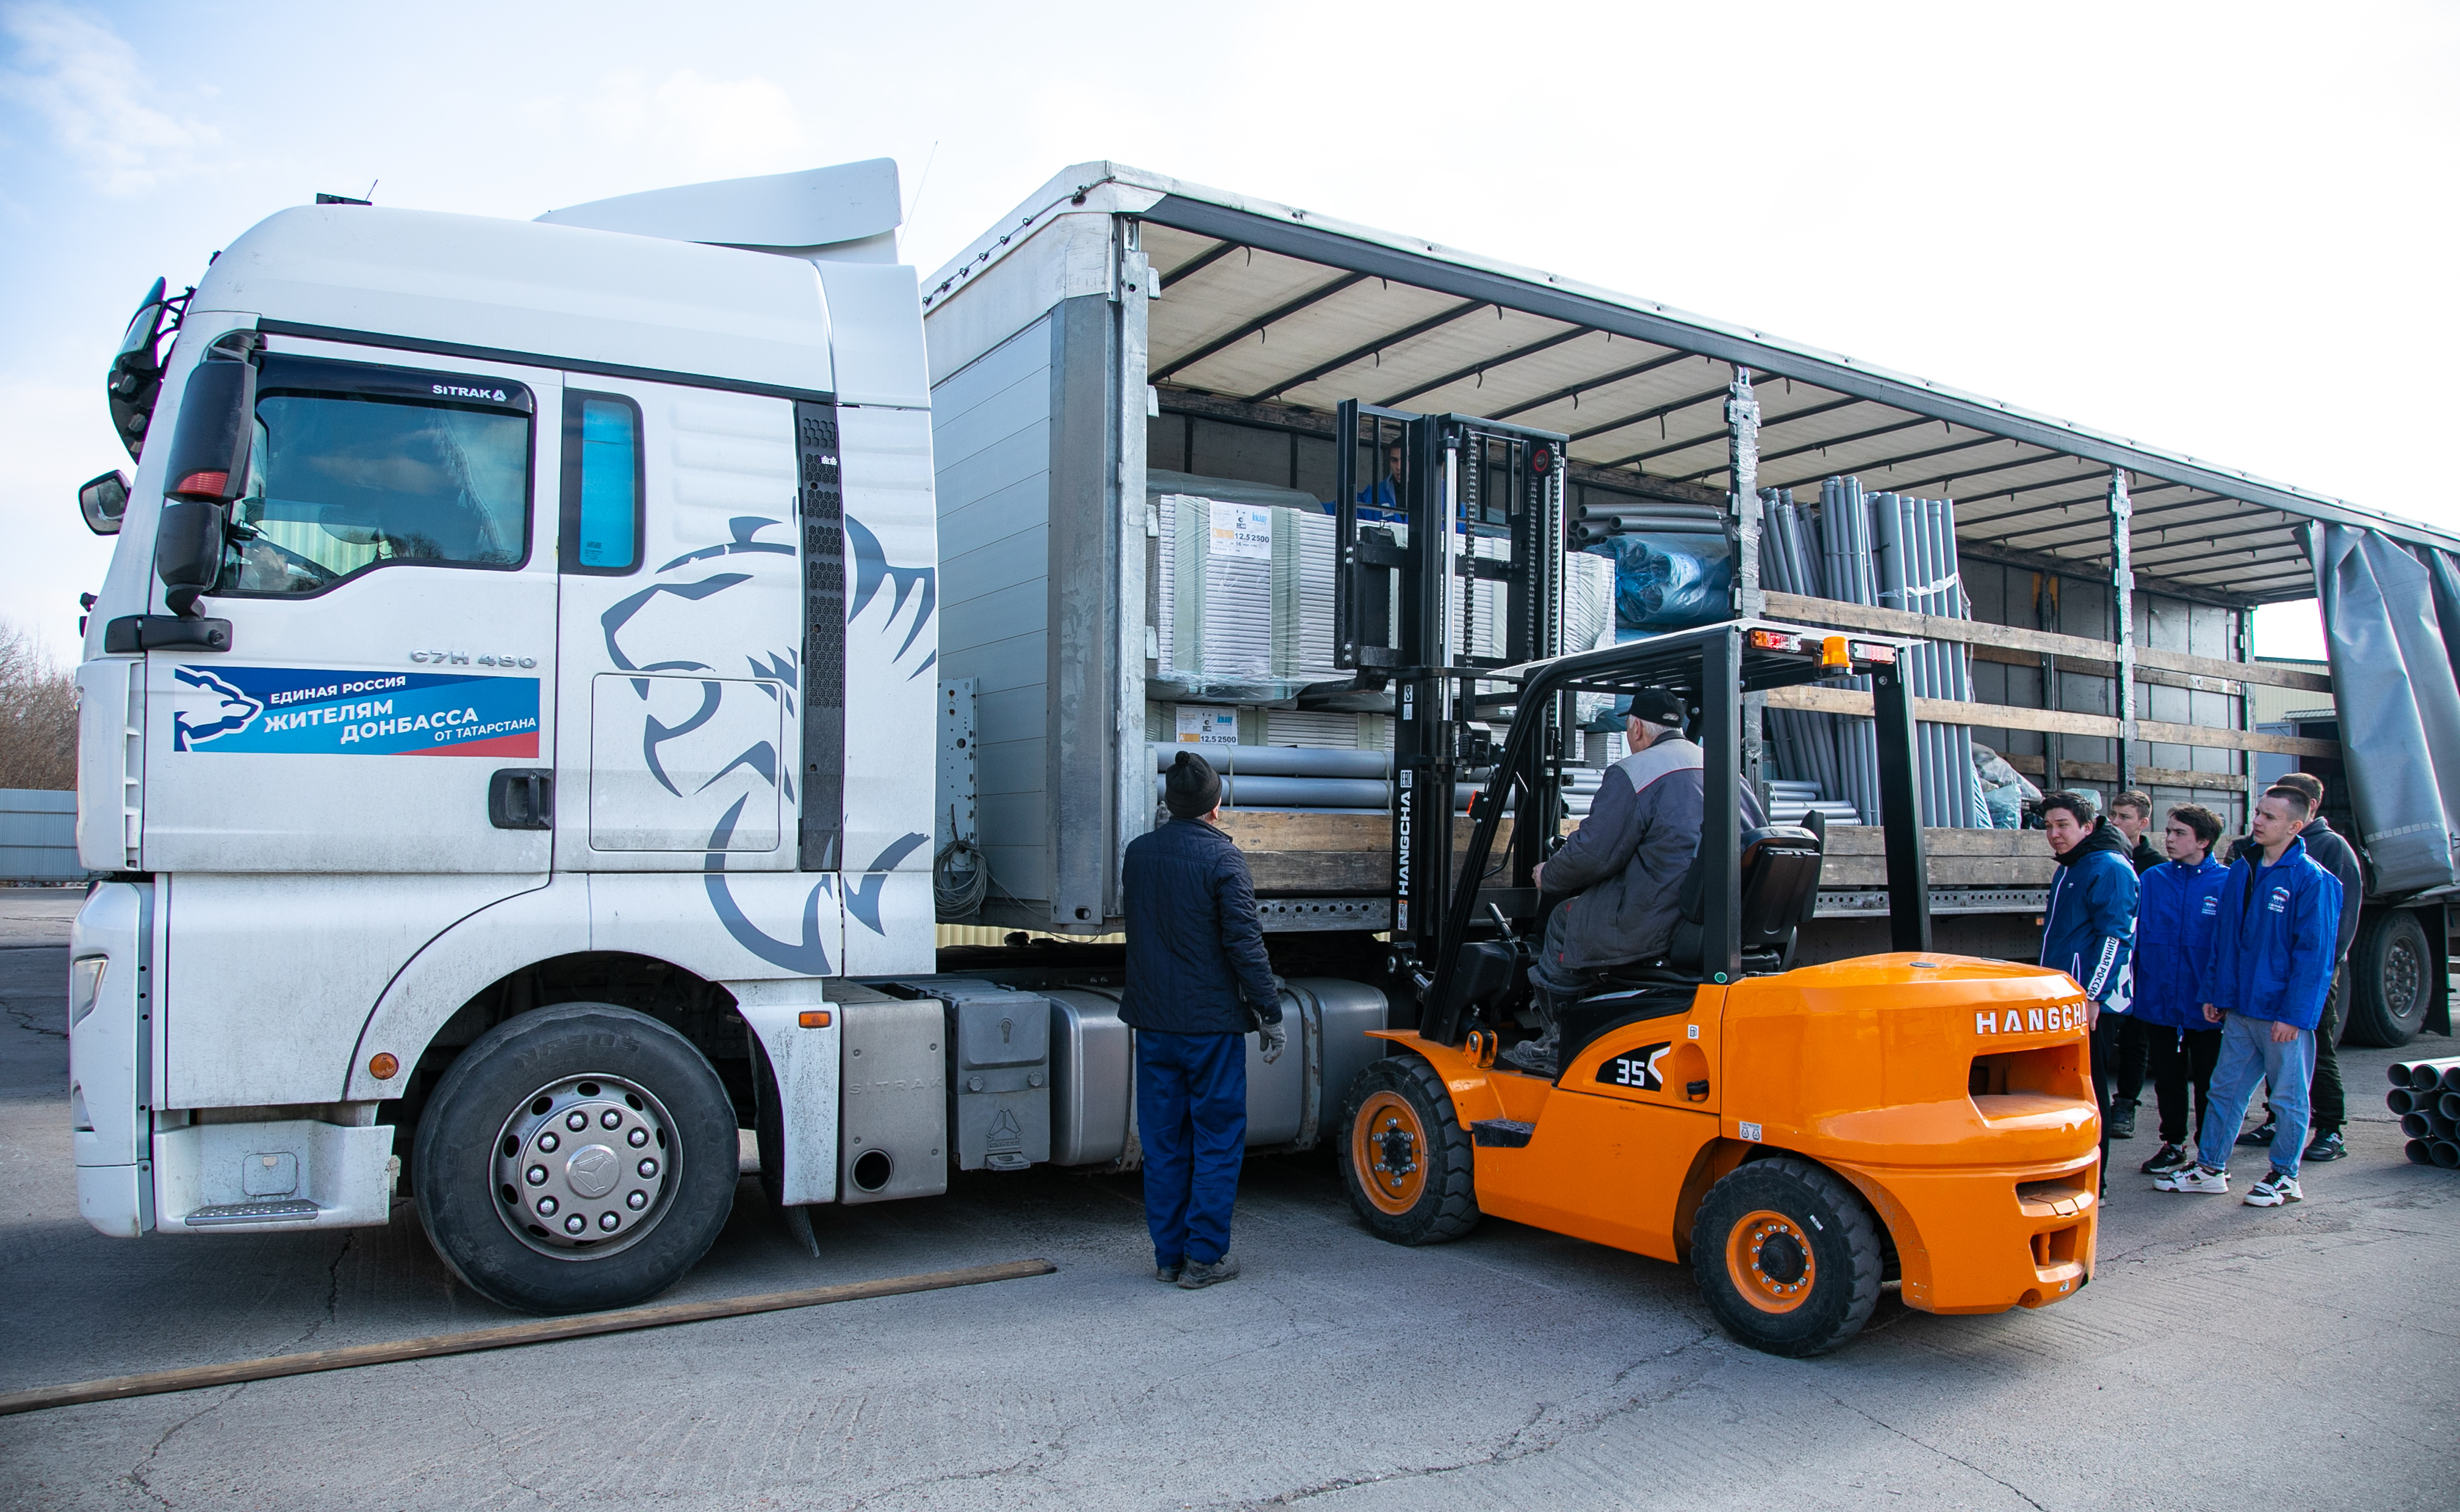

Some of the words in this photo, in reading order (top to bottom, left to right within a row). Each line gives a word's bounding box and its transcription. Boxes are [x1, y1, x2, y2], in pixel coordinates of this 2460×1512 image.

[432, 385, 491, 398] SITRAK
[1252, 512, 1267, 525] KNAUF
[1251, 534, 1270, 543] 2500
[411, 649, 470, 665] C7H
[478, 652, 538, 668] 480
[270, 684, 337, 704] ЕДИНАЯ
[342, 675, 406, 694] РОССИЯ
[263, 699, 393, 733] ЖИТЕЛЯМ
[340, 707, 479, 745] ДОНБАССА
[434, 729, 453, 742] ОТ
[456, 717, 536, 739] ТАТАРСТАНА
[1217, 713, 1234, 726] KNAUF
[1398, 790, 1411, 896] HANGCHA
[2102, 936, 2117, 967] ДИНАЯ
[2087, 967, 2107, 998] РОССИЯ
[1976, 1000, 2088, 1034] HANGCHA
[850, 1076, 943, 1095] SITRAK
[1616, 1058, 1645, 1087] 35
